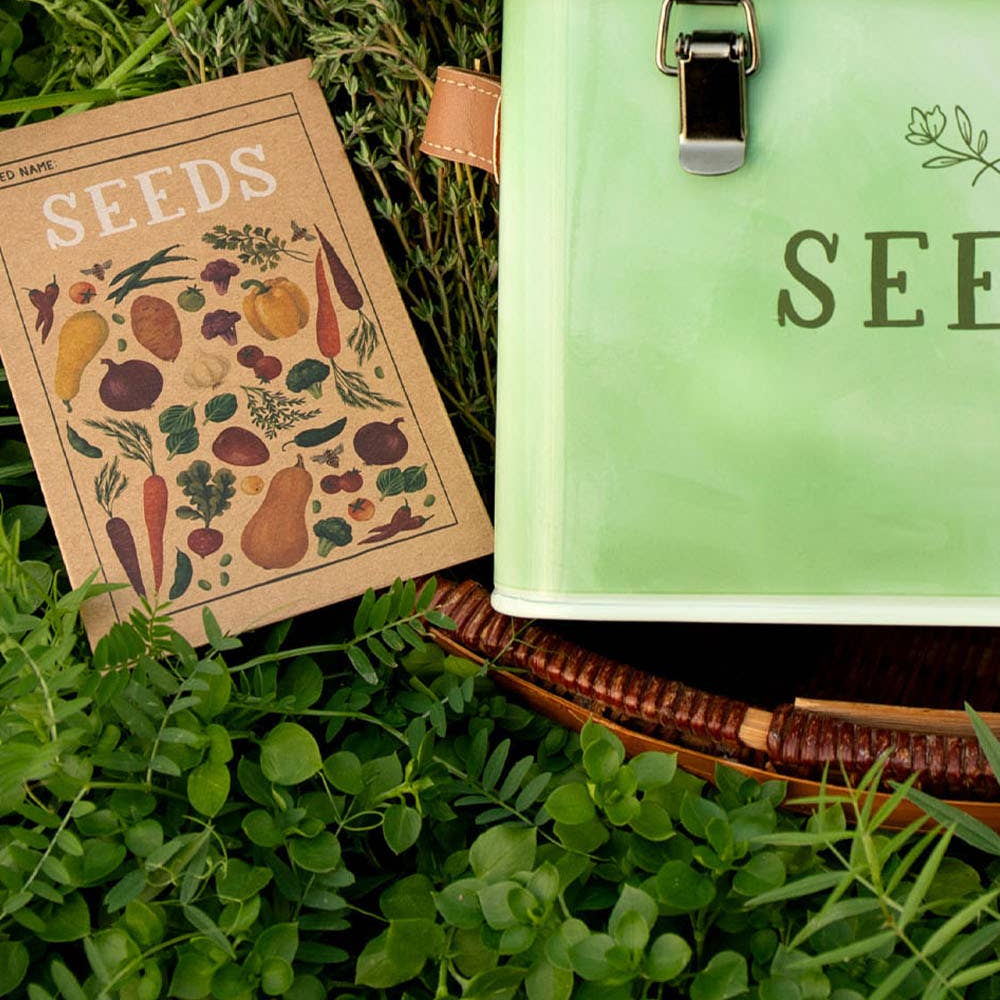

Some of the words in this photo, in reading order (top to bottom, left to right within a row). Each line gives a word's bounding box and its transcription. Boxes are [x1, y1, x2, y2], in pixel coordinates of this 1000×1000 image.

[0, 170, 15, 182] ED
[19, 160, 58, 177] NAME:
[42, 144, 277, 250] SEEDS
